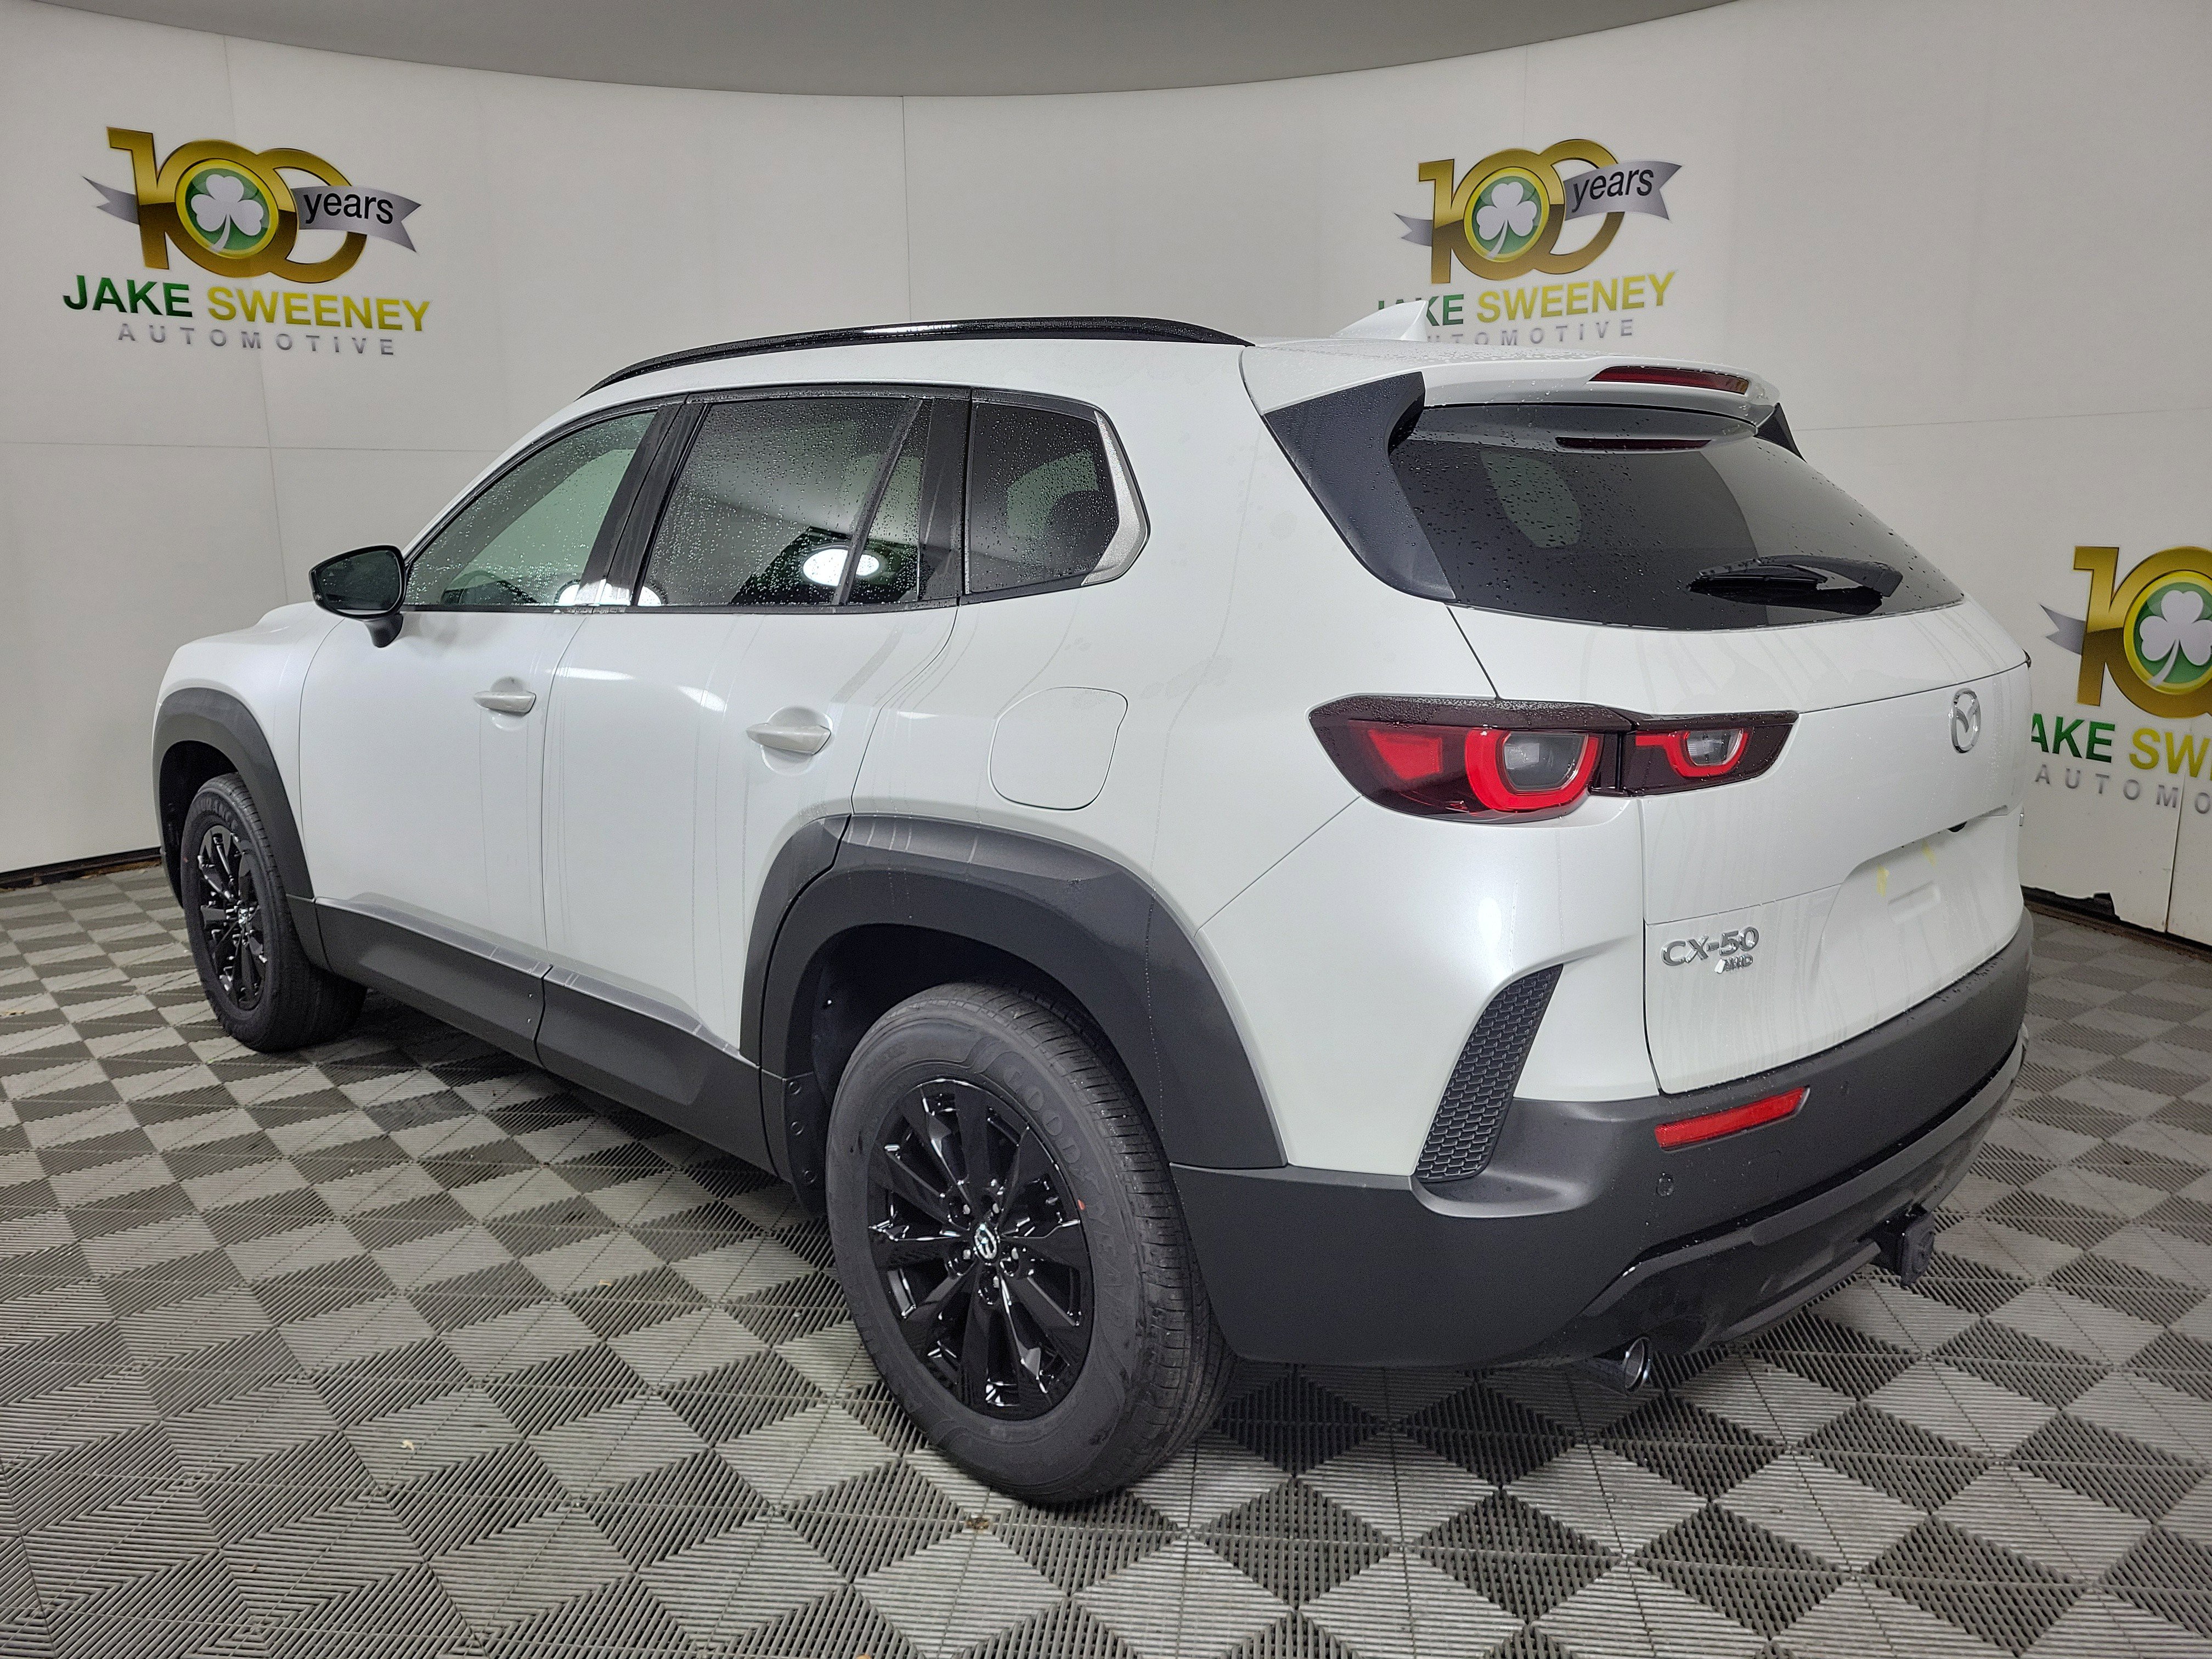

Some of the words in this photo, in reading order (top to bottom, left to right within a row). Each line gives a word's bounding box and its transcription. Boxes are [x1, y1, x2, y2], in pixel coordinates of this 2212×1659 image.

[106, 127, 366, 283] 100
[303, 192, 394, 224] years
[1419, 139, 1626, 284] 100
[1571, 168, 1654, 213] years
[62, 275, 193, 318] JAKE
[207, 286, 430, 331] SWEENEY
[1378, 294, 1464, 326] KE
[1476, 269, 1678, 323] SWEENEY
[118, 323, 394, 356] AUTOMOTIVE
[1427, 319, 1633, 346] TOMOTIVE
[2073, 545, 2212, 719] 10
[2031, 713, 2115, 763] AKE
[2129, 727, 2212, 781] SW
[1661, 926, 1759, 966] CX-50
